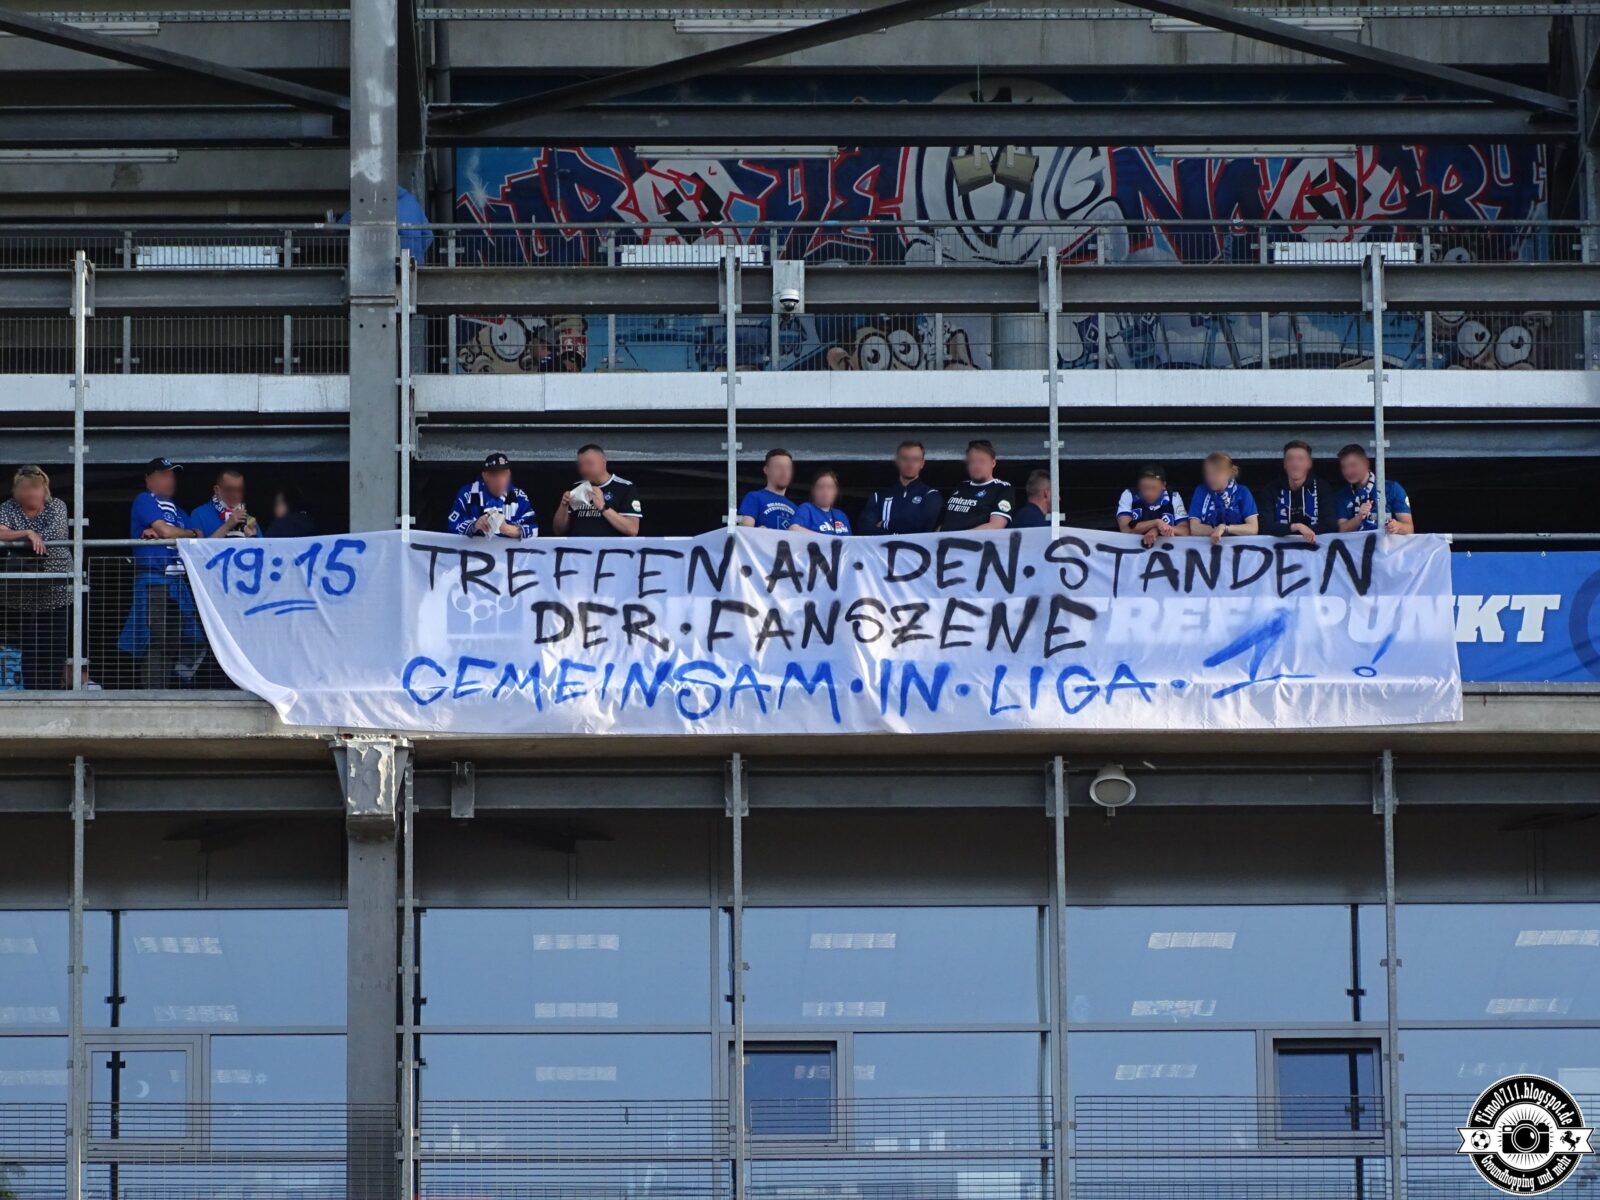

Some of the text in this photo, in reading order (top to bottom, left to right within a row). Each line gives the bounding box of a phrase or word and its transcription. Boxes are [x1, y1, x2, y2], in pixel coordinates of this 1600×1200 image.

[206, 539, 366, 596] 19:15
[409, 533, 1377, 598] TREFFEN AN DEN STÄNDEN
[530, 601, 669, 652] DER
[706, 594, 1098, 659] FANSZENE
[402, 655, 841, 724] GEMEINSAM
[881, 658, 950, 717] IN
[990, 663, 1156, 716] LIGA
